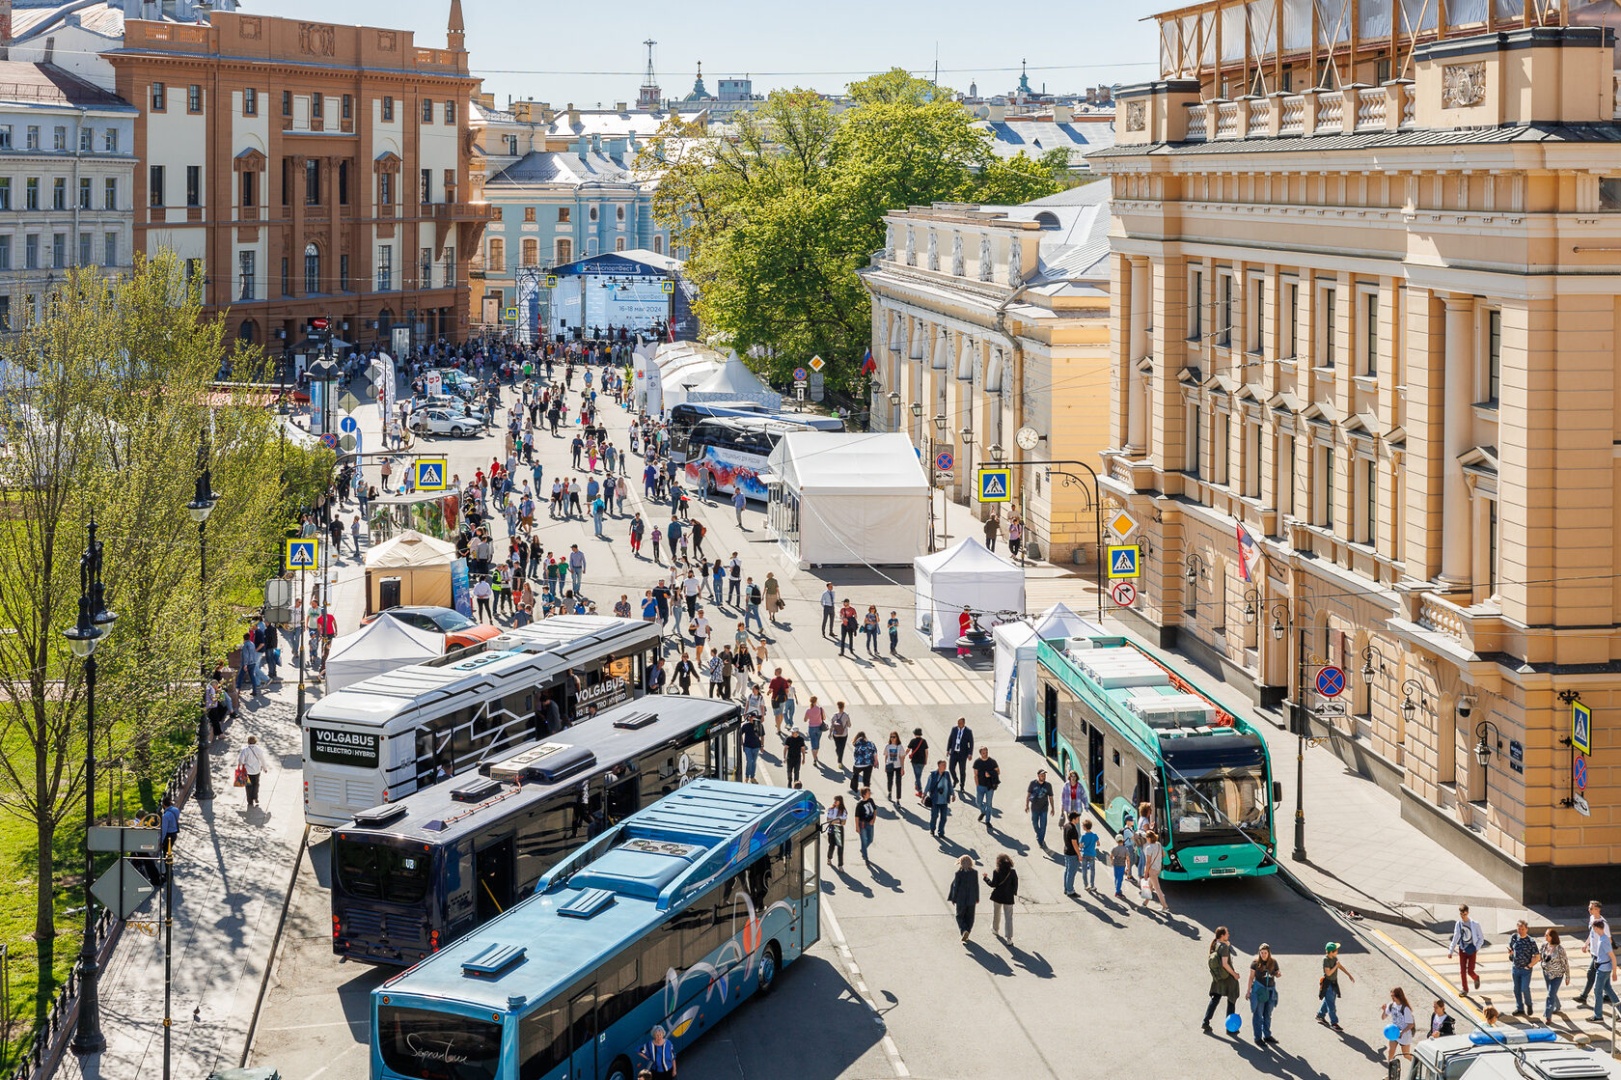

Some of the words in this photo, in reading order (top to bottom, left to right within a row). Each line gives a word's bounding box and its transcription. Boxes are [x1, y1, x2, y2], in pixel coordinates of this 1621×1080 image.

[575, 676, 625, 703] VOLGABUS
[585, 700, 607, 713] ETRO
[316, 730, 375, 746] VOLGABUS
[327, 746, 352, 755] ELECTRO
[354, 749, 376, 758] HYBRID
